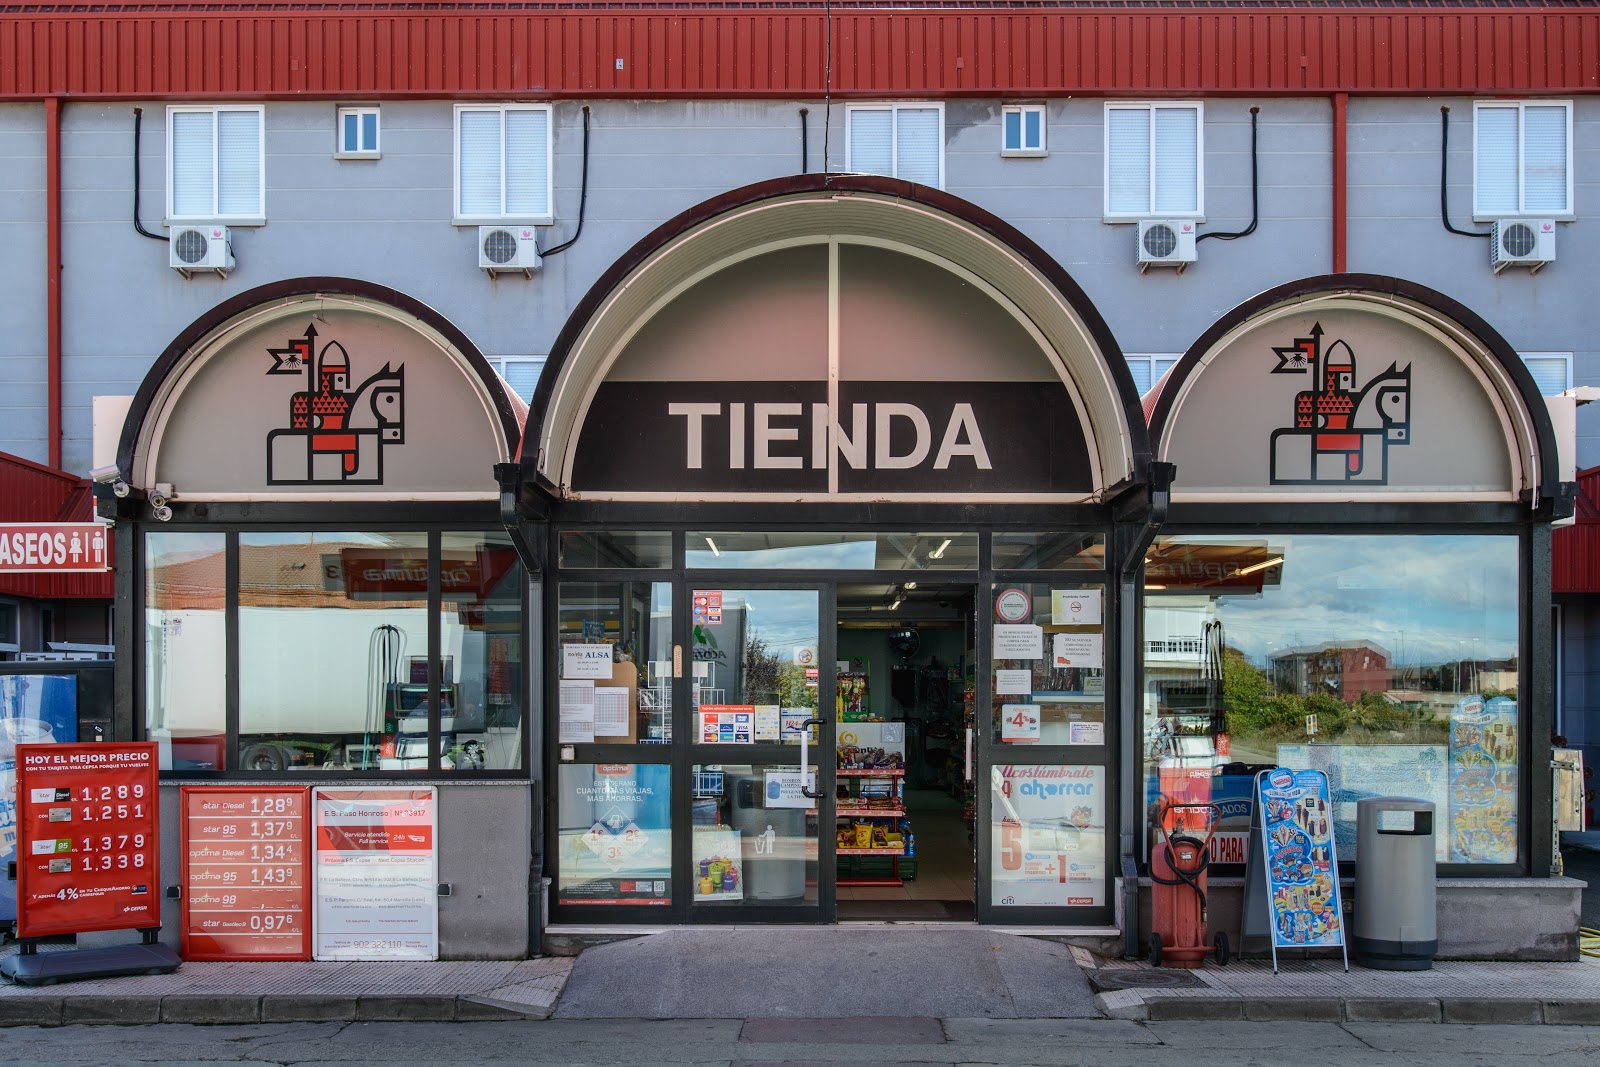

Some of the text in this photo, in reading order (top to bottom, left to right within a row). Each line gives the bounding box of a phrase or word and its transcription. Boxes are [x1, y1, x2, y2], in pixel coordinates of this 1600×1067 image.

[668, 403, 992, 470] TIENDA
[0, 532, 66, 565] ASEOS
[1013, 713, 1030, 727] 4%
[26, 752, 149, 764] HOY EL MEJOR PRECIO
[1002, 765, 1094, 778] Acostúmbrate
[82, 784, 144, 802] 1,289
[82, 804, 144, 822] 1,251
[222, 825, 236, 834] 95
[58, 842, 69, 850] 95
[82, 834, 145, 852] 1,379
[1220, 837, 1244, 862] PARA
[82, 854, 145, 871] 1,338
[190, 873, 220, 881] optima
[223, 872, 237, 881] 95
[57, 888, 79, 900] 4%
[222, 895, 236, 904] 98
[1002, 896, 1015, 905] citi
[354, 940, 370, 948] 902
[372, 940, 386, 948] 322
[389, 940, 401, 948] 110
